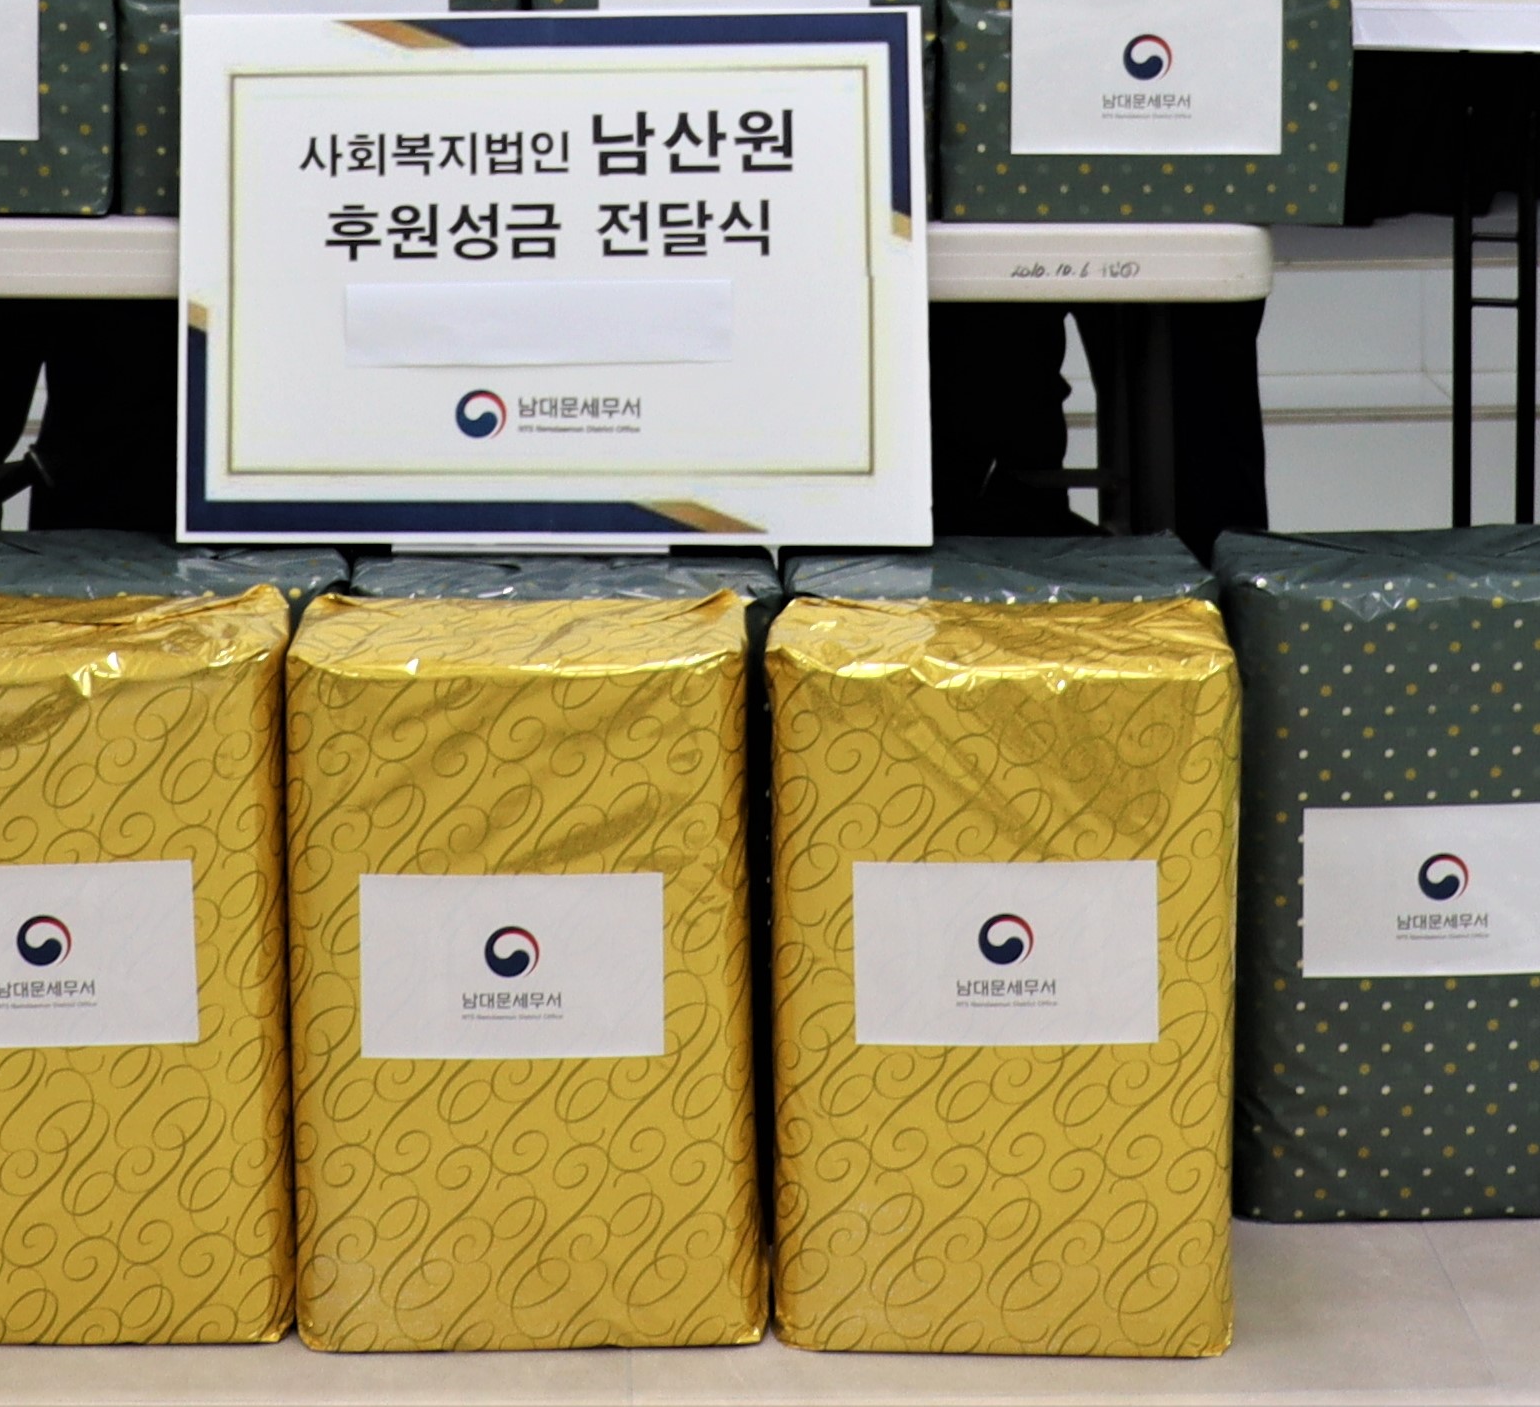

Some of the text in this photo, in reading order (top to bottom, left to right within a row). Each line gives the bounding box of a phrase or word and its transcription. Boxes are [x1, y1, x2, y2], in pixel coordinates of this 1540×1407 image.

[1102, 94, 1191, 110] 남대문세무서
[299, 108, 796, 178] 사회복지법인 남산원
[324, 198, 773, 261] 후원성금 전달식
[518, 396, 642, 419] 남대문세무서
[956, 979, 1057, 998] 남대문세무서
[461, 991, 563, 1010] 남대문세무서
